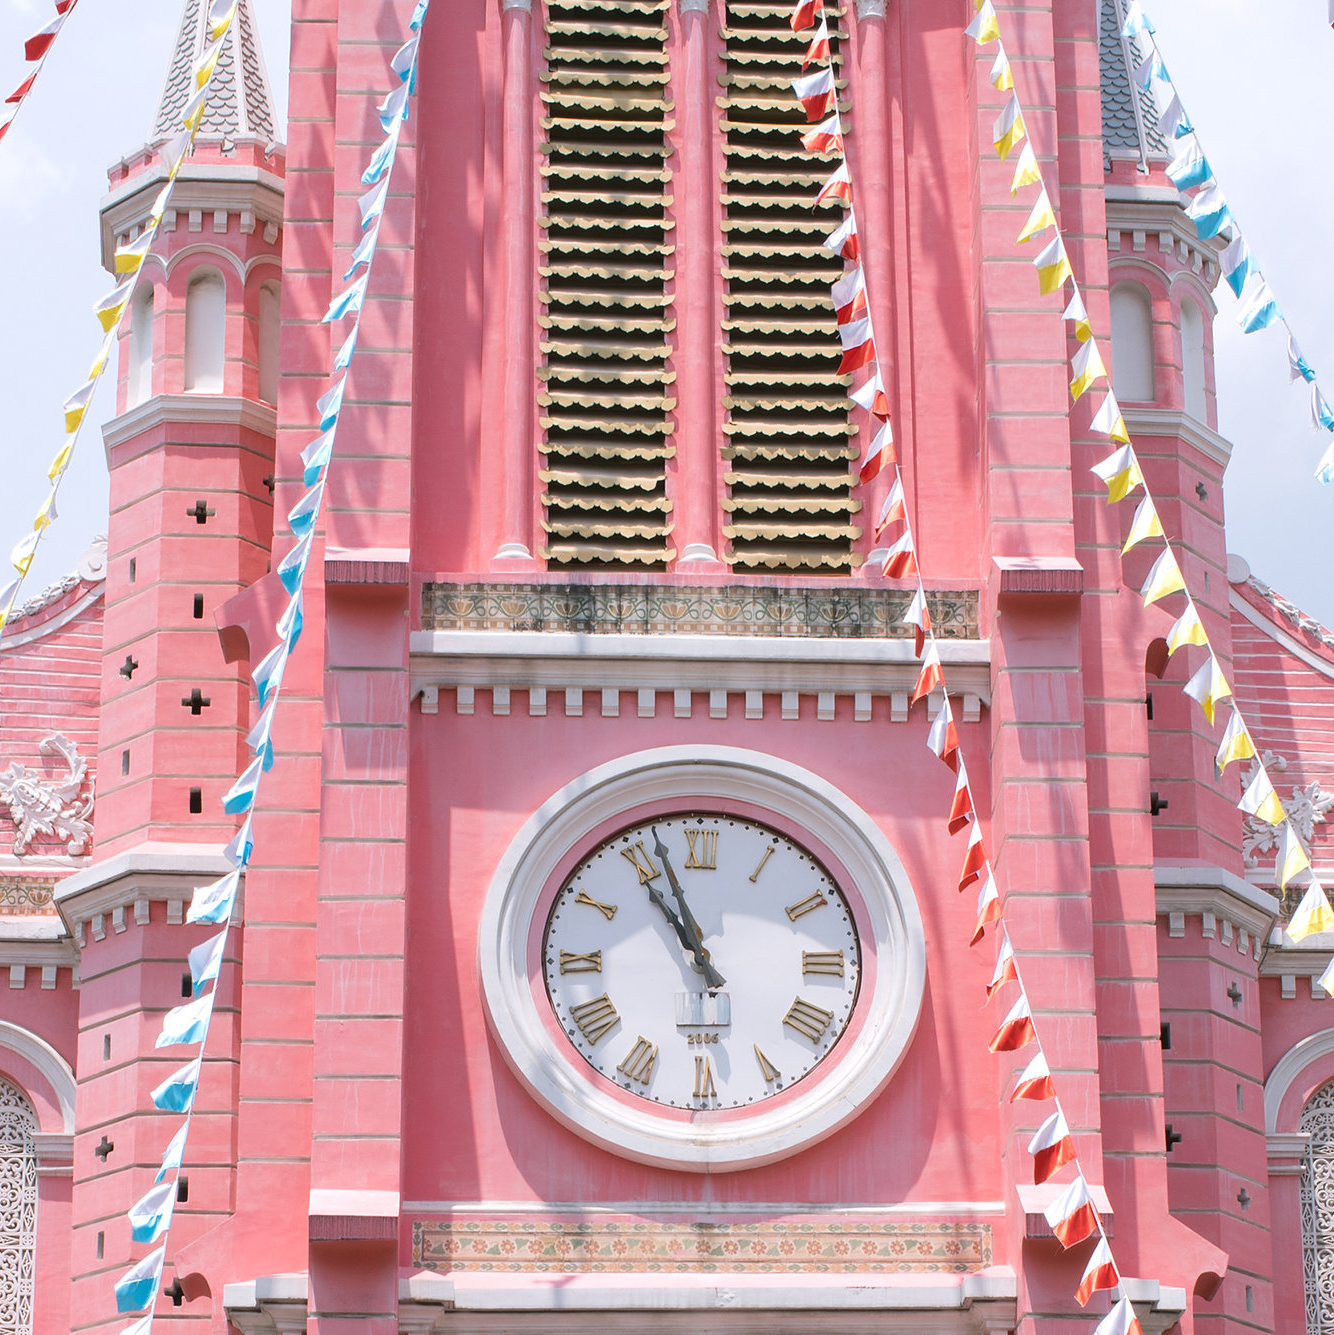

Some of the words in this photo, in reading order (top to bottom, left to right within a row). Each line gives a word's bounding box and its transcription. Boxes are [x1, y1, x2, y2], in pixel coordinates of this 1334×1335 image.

[620, 840, 661, 885] XI
[684, 829, 720, 870] XII
[574, 888, 618, 921] X
[784, 889, 828, 922] II
[802, 949, 844, 977] III
[569, 992, 621, 1045] VIII
[687, 1032, 719, 1044] 2006
[616, 1035, 659, 1085] VII
